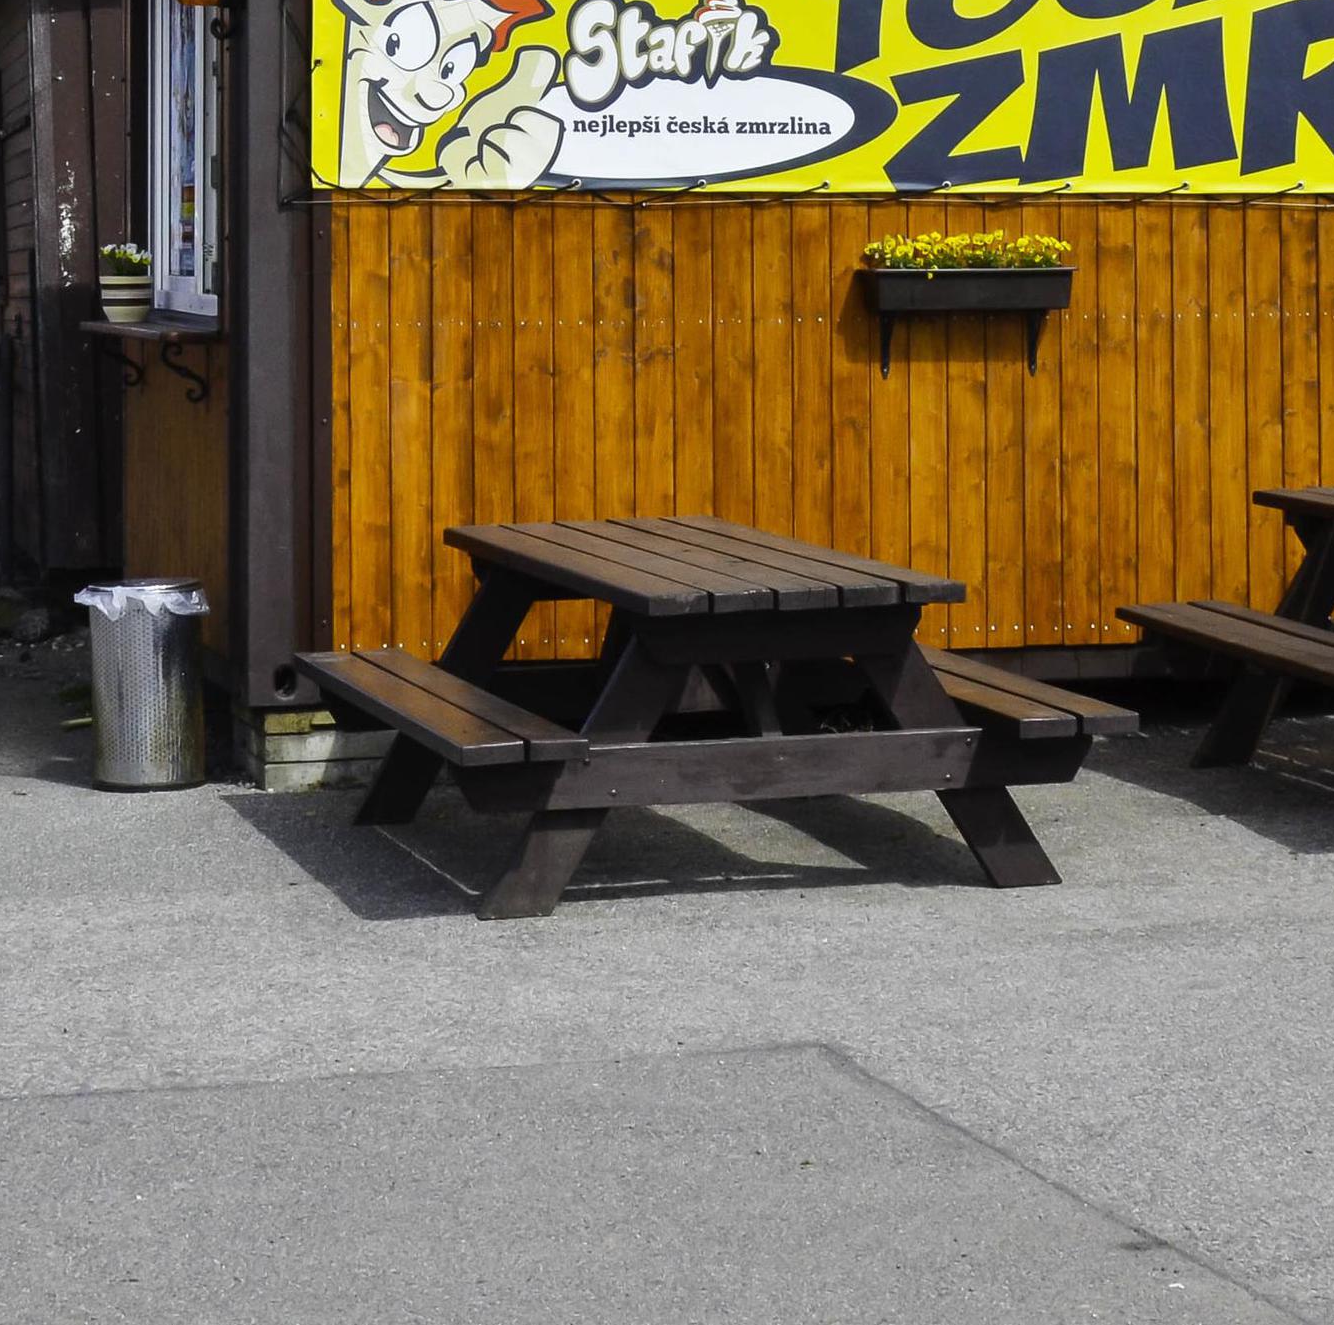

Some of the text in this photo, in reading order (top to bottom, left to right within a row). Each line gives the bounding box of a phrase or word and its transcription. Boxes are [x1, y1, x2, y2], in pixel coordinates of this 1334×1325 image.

[572, 116, 832, 138] nejlepší česká zmrzlina
